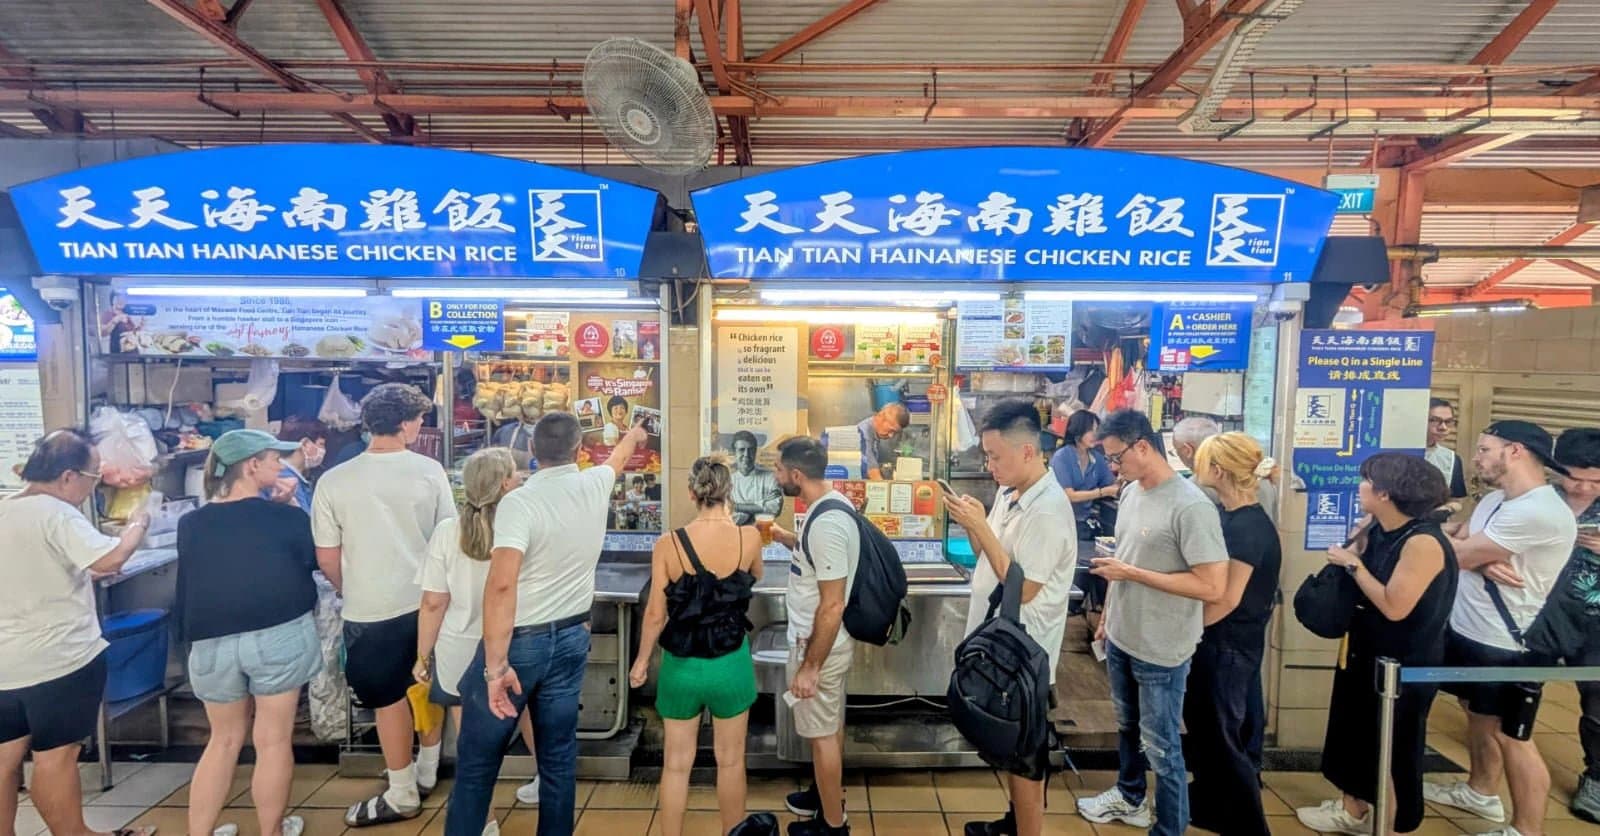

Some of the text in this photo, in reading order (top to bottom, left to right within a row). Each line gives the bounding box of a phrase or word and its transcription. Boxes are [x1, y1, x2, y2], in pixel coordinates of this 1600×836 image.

[56, 186, 516, 235] 天天海南雞飯
[735, 190, 1194, 238] 天天海南雞飯
[571, 234, 593, 242] tian
[1248, 238, 1269, 247] tian
[575, 242, 597, 250] tian
[1251, 247, 1272, 255] tian
[60, 243, 517, 262] TIAN TIAN HAINANESE CHICKEN RICE
[735, 248, 1191, 266] TIAN TIAN HAINANESE CHICKEN RICE
[430, 301, 443, 318] B
[446, 311, 498, 319] COLLECTION
[1192, 313, 1231, 321] CASHIER
[1169, 314, 1184, 330] A
[769, 332, 783, 342] rice
[753, 344, 786, 355] fragrant
[743, 355, 776, 364] delicious
[1308, 356, 1340, 366] Please
[1341, 357, 1350, 366] Q
[1351, 356, 1360, 366] in
[1369, 357, 1400, 368] Single
[1402, 358, 1423, 367] Line
